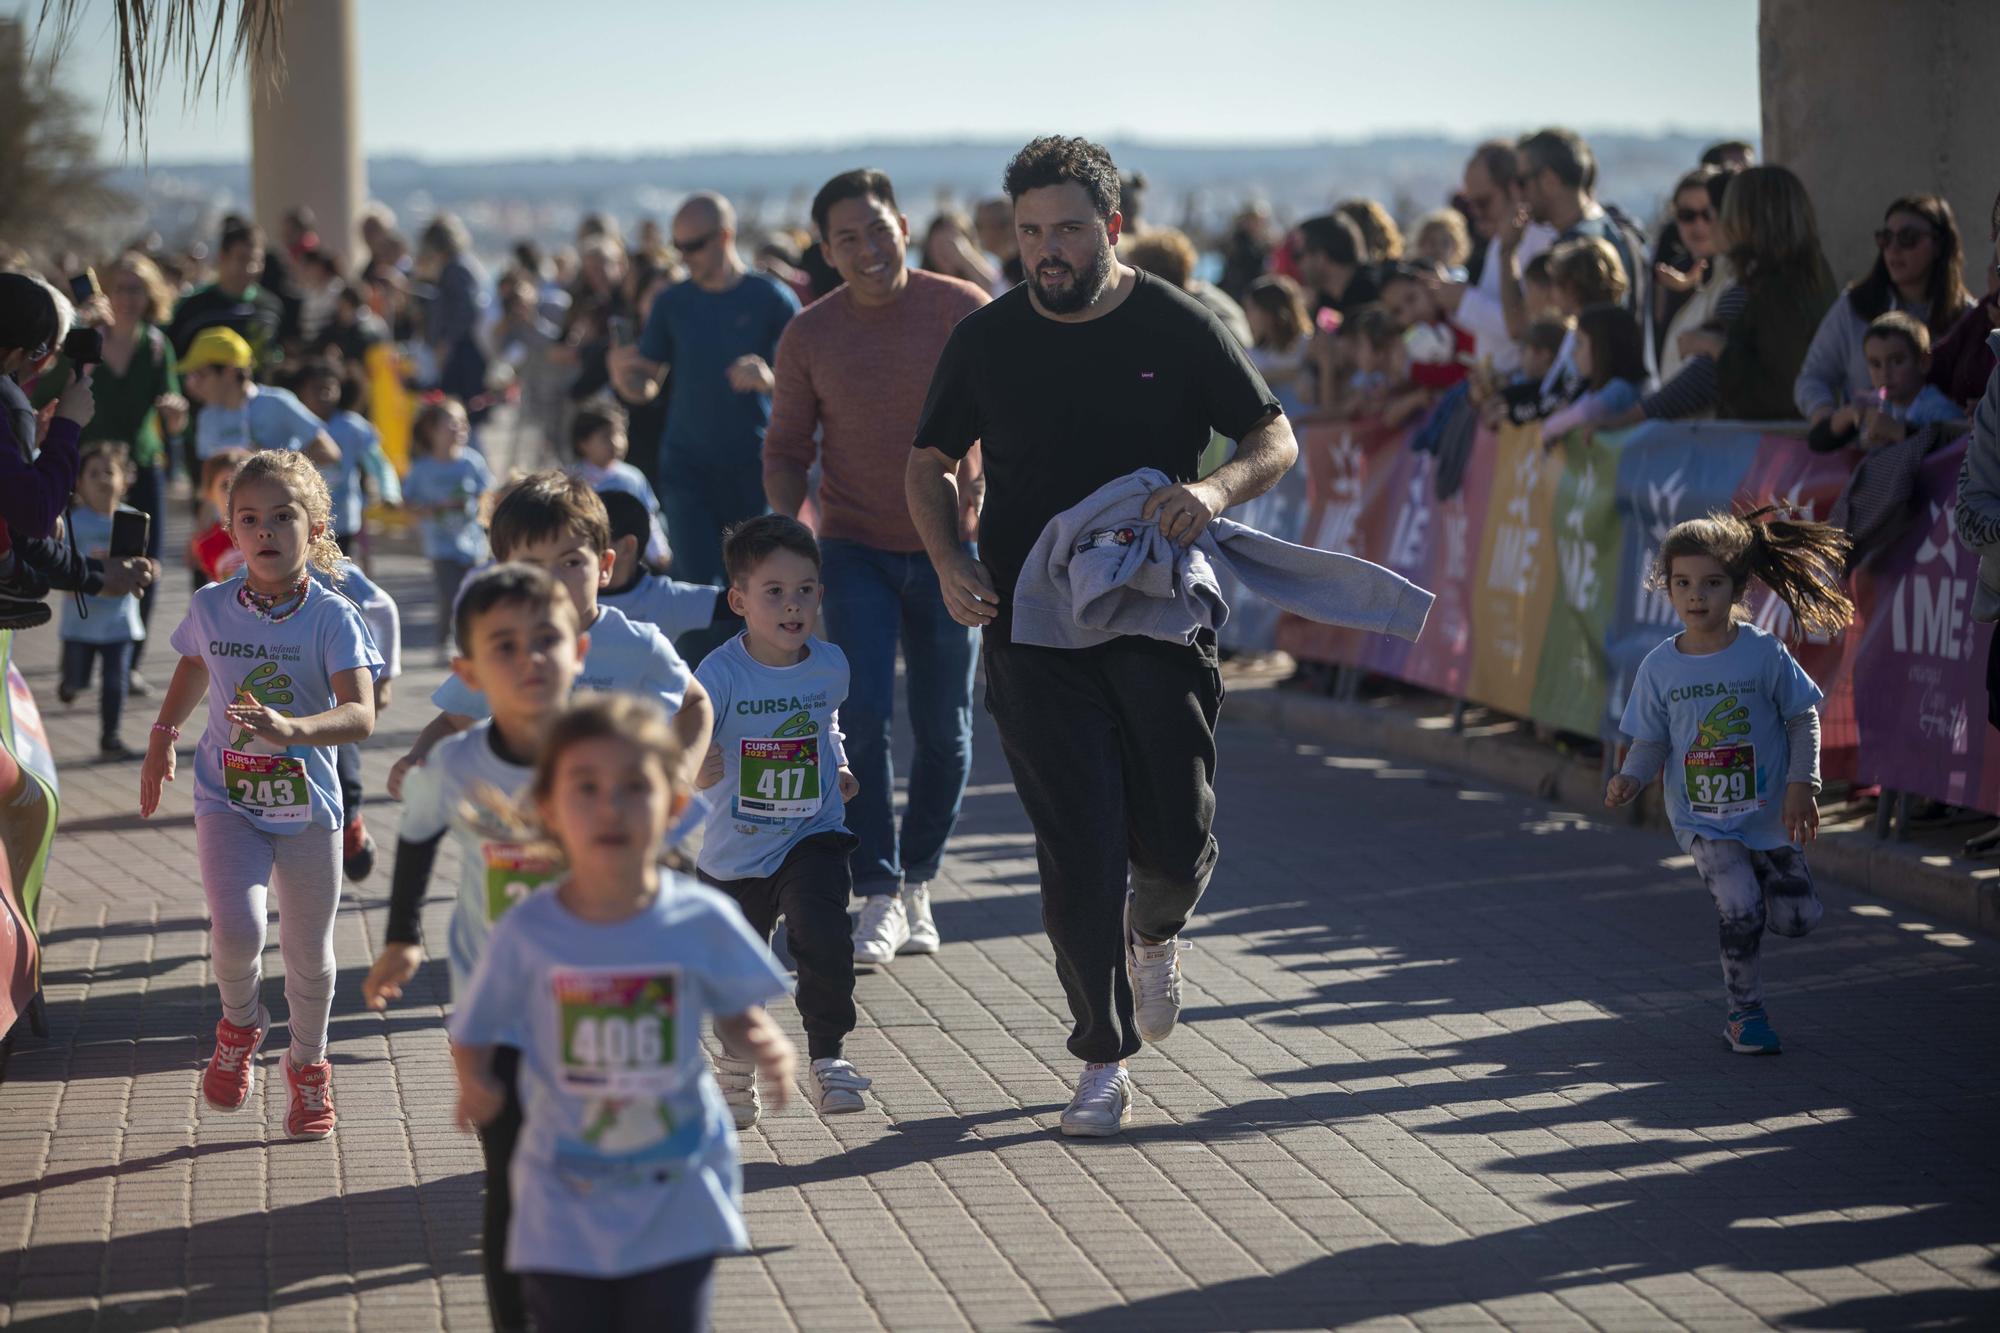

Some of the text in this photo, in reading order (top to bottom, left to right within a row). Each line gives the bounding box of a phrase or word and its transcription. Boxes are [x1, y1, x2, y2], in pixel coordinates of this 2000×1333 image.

[1892, 573, 1969, 661] IME
[209, 641, 301, 659] CURSA infantil
[1671, 682, 1728, 702] CURSA
[736, 696, 803, 715] CURSA
[744, 749, 767, 758] 2023
[745, 742, 780, 751] CURSA
[1687, 751, 1716, 760] CURSA
[226, 753, 257, 765] CURSA
[226, 761, 246, 770] 2023
[756, 767, 805, 799] 417
[1696, 772, 1746, 803] 329
[237, 779, 295, 807] 243
[571, 1016, 662, 1068] 406
